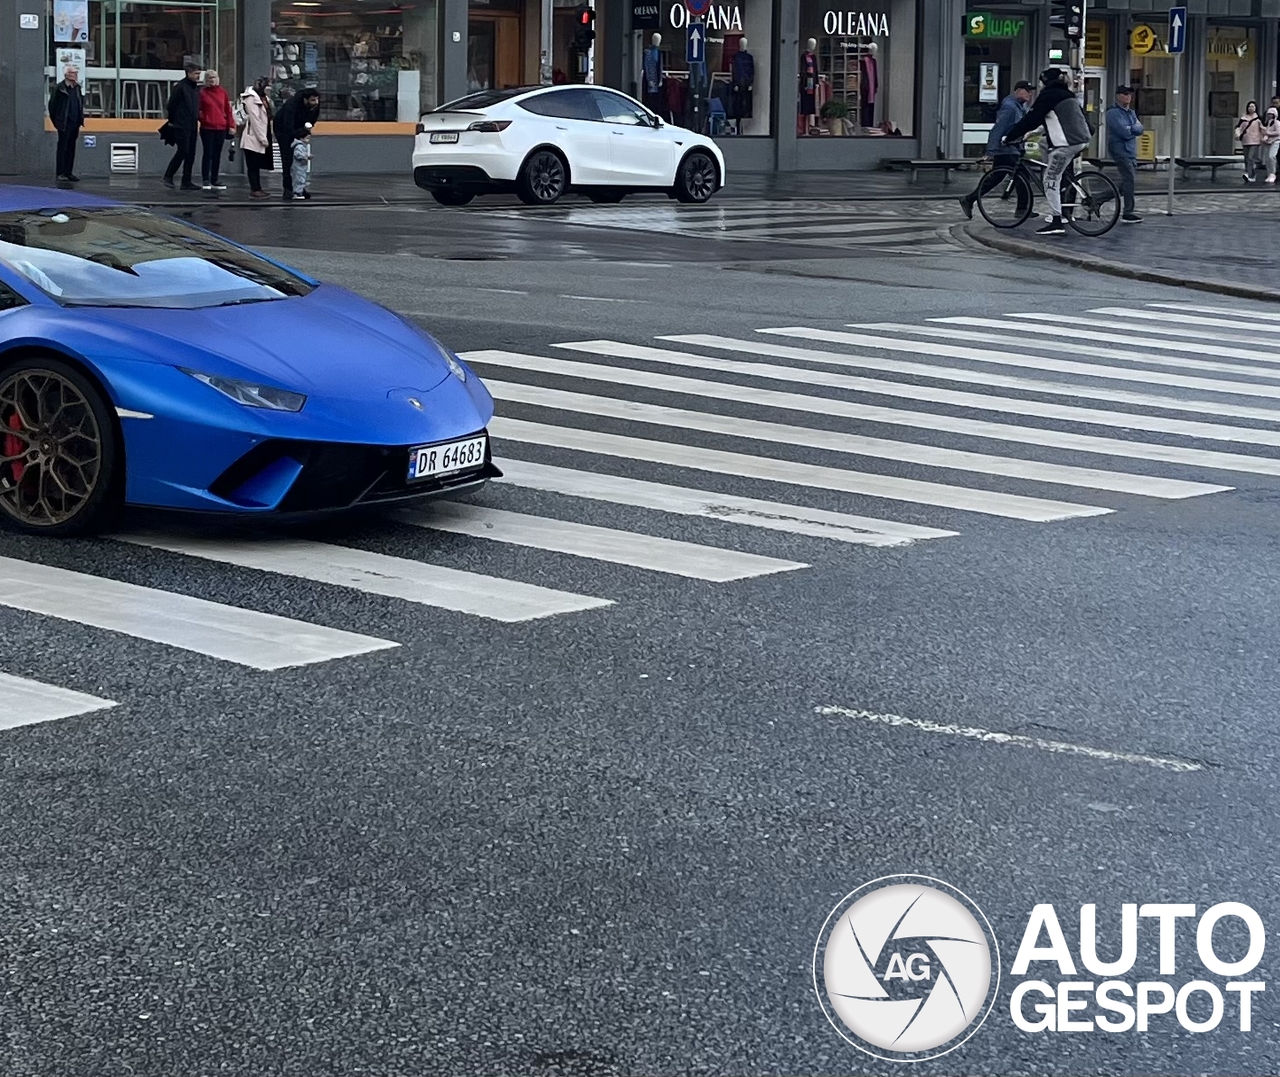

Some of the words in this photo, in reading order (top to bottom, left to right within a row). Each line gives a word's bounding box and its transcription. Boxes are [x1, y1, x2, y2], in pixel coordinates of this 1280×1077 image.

[634, 5, 658, 17] OLEANA
[823, 10, 890, 37] OLEANA
[418, 450, 438, 474] DR
[442, 440, 483, 469] 64683
